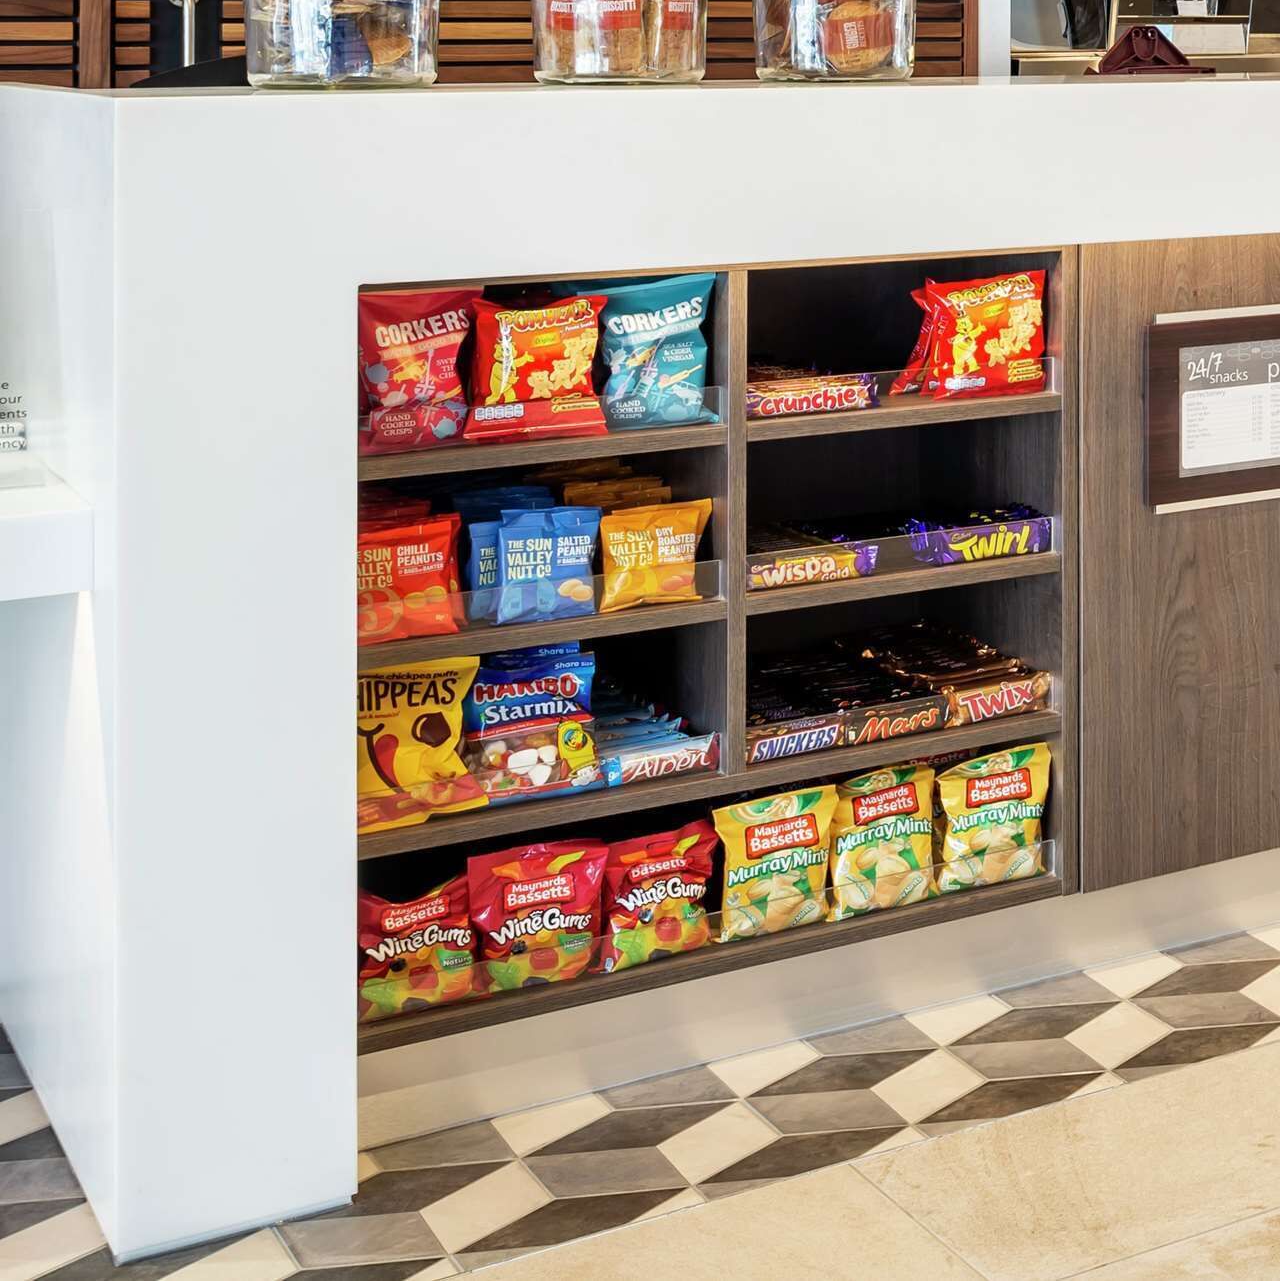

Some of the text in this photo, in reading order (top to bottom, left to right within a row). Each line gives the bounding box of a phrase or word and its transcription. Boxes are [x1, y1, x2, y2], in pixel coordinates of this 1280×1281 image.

[608, 297, 703, 335] CORKERS
[376, 309, 470, 347] CORKERS
[676, 341, 695, 349] SALT
[661, 353, 695, 363] VINEGAR
[1188, 352, 1223, 380] 24/7
[1210, 369, 1248, 384] snacks
[615, 399, 641, 408] HAND
[760, 386, 858, 415] crunchie
[385, 413, 411, 423] HAND
[610, 406, 645, 414] COOKED
[381, 420, 416, 430] COOKED
[384, 427, 413, 436] CRISPS
[507, 538, 552, 551] THE SUN
[558, 535, 590, 546] SALTED
[609, 530, 651, 543] THE SUN
[658, 533, 696, 546] ROASTED
[950, 525, 1031, 561] Twirl
[363, 547, 391, 561] SUN
[397, 543, 428, 556] CHILLI
[480, 548, 496, 557] THE
[609, 541, 654, 556] VALLEY
[658, 544, 696, 556] PEANUTS
[397, 552, 443, 567] PEANUTS
[507, 551, 553, 567] VALLEY
[357, 561, 392, 577] ALLEY
[508, 565, 534, 580] NUT
[539, 648, 565, 656] Share
[555, 661, 579, 670] Share
[384, 672, 431, 680] chickpea
[474, 672, 580, 704] HARIBO
[484, 697, 577, 724] Starmix
[856, 708, 939, 744] Mars
[752, 726, 838, 762] SNICKERS
[975, 772, 1023, 790] Maynards
[860, 787, 909, 806] Maynards
[971, 781, 1027, 803] Bassetts
[858, 797, 914, 819] Bassetts
[951, 805, 1009, 832] Murray
[755, 818, 808, 838] Maynards
[751, 826, 814, 853] Bassetts
[836, 825, 896, 854] Murray
[630, 858, 687, 879] Bassetts
[728, 856, 792, 886] Murray
[512, 875, 567, 894] Maynards
[507, 884, 572, 907] Bassetts
[388, 897, 443, 917] Maynards
[385, 903, 445, 931] Bassetts
